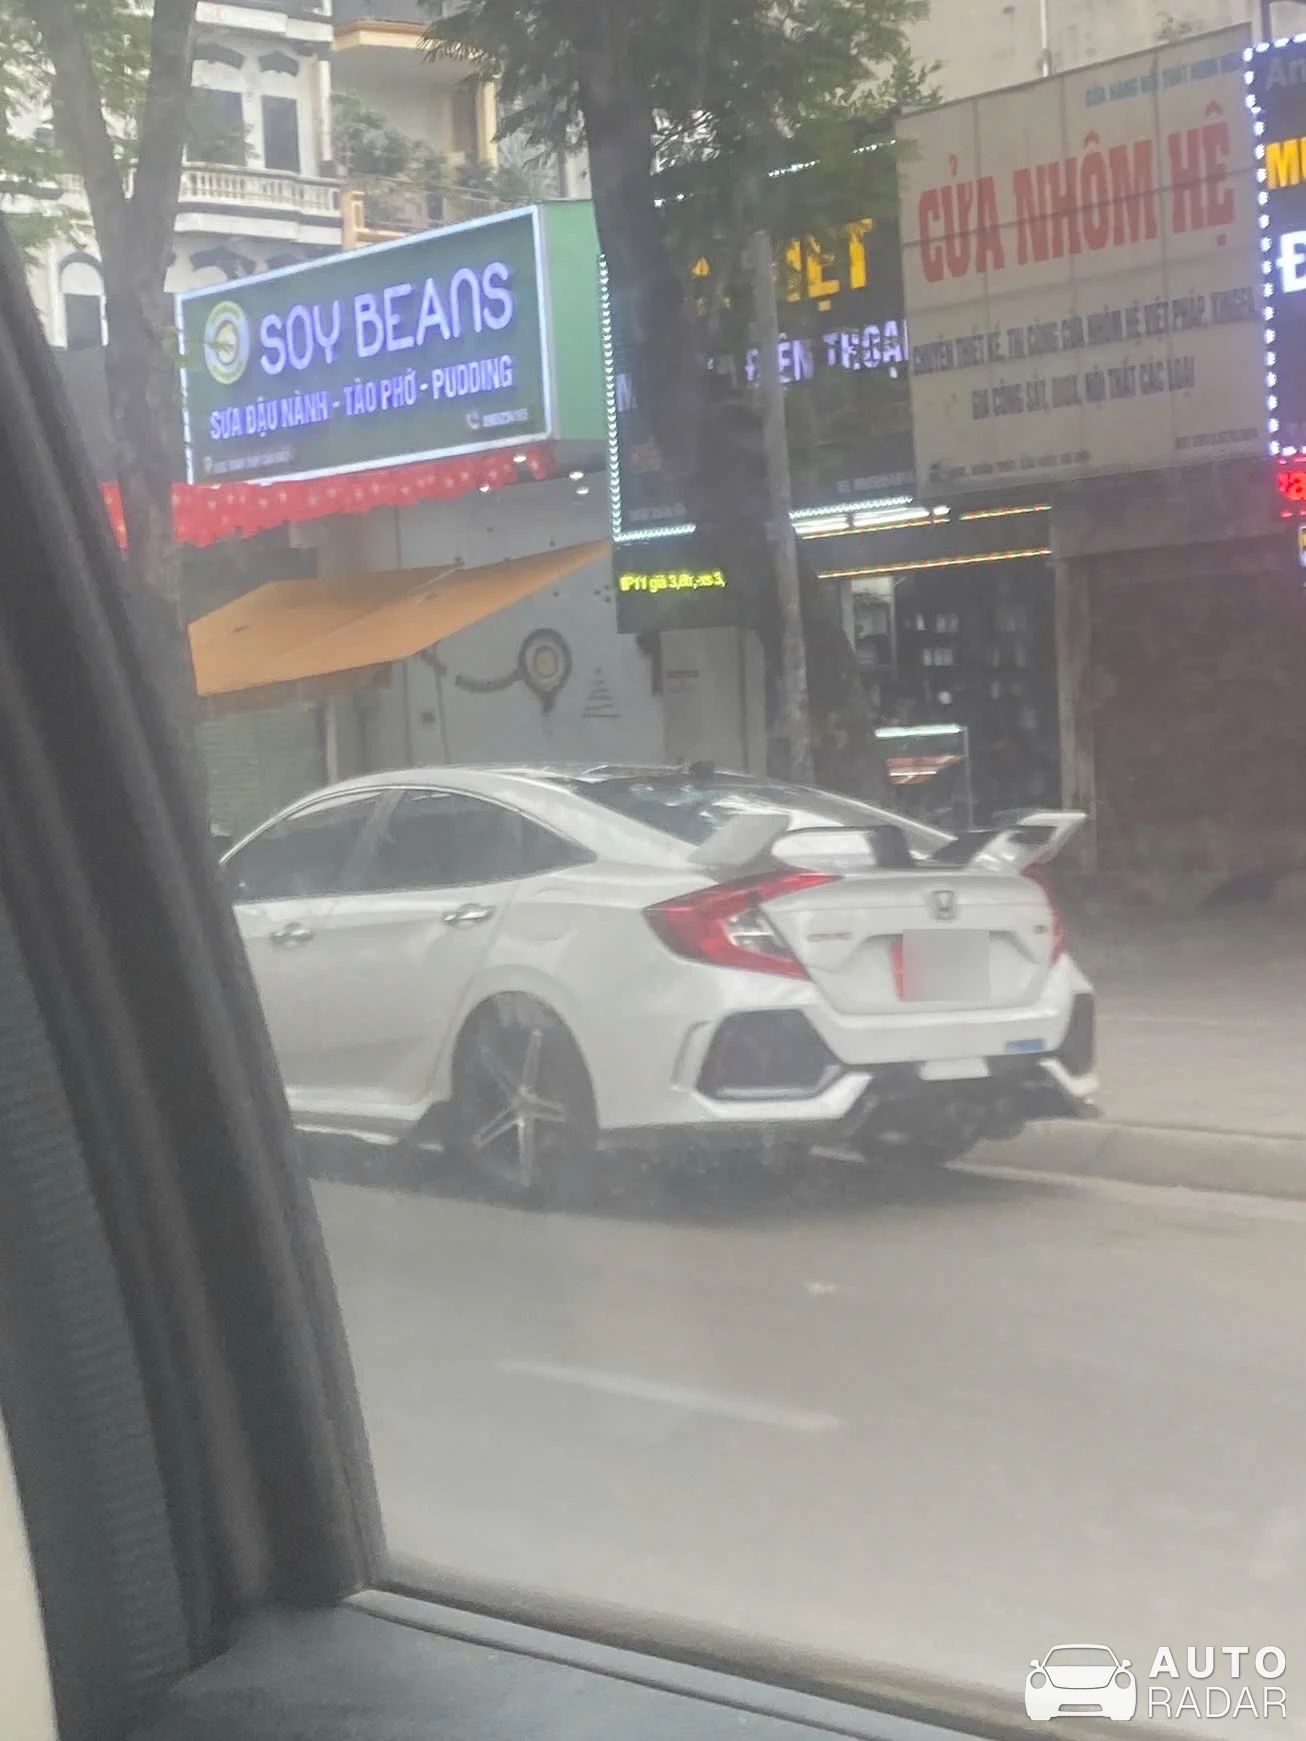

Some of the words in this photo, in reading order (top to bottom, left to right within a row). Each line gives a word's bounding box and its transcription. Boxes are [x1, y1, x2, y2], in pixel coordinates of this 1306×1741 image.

[917, 153, 1005, 283] CỬA
[1012, 130, 1158, 266] NHÔM
[1167, 100, 1235, 248] HỆ
[258, 300, 342, 375] SOY
[354, 262, 515, 359] BEANS
[380, 366, 418, 410] PHỚ
[432, 354, 514, 400] PUDDING
